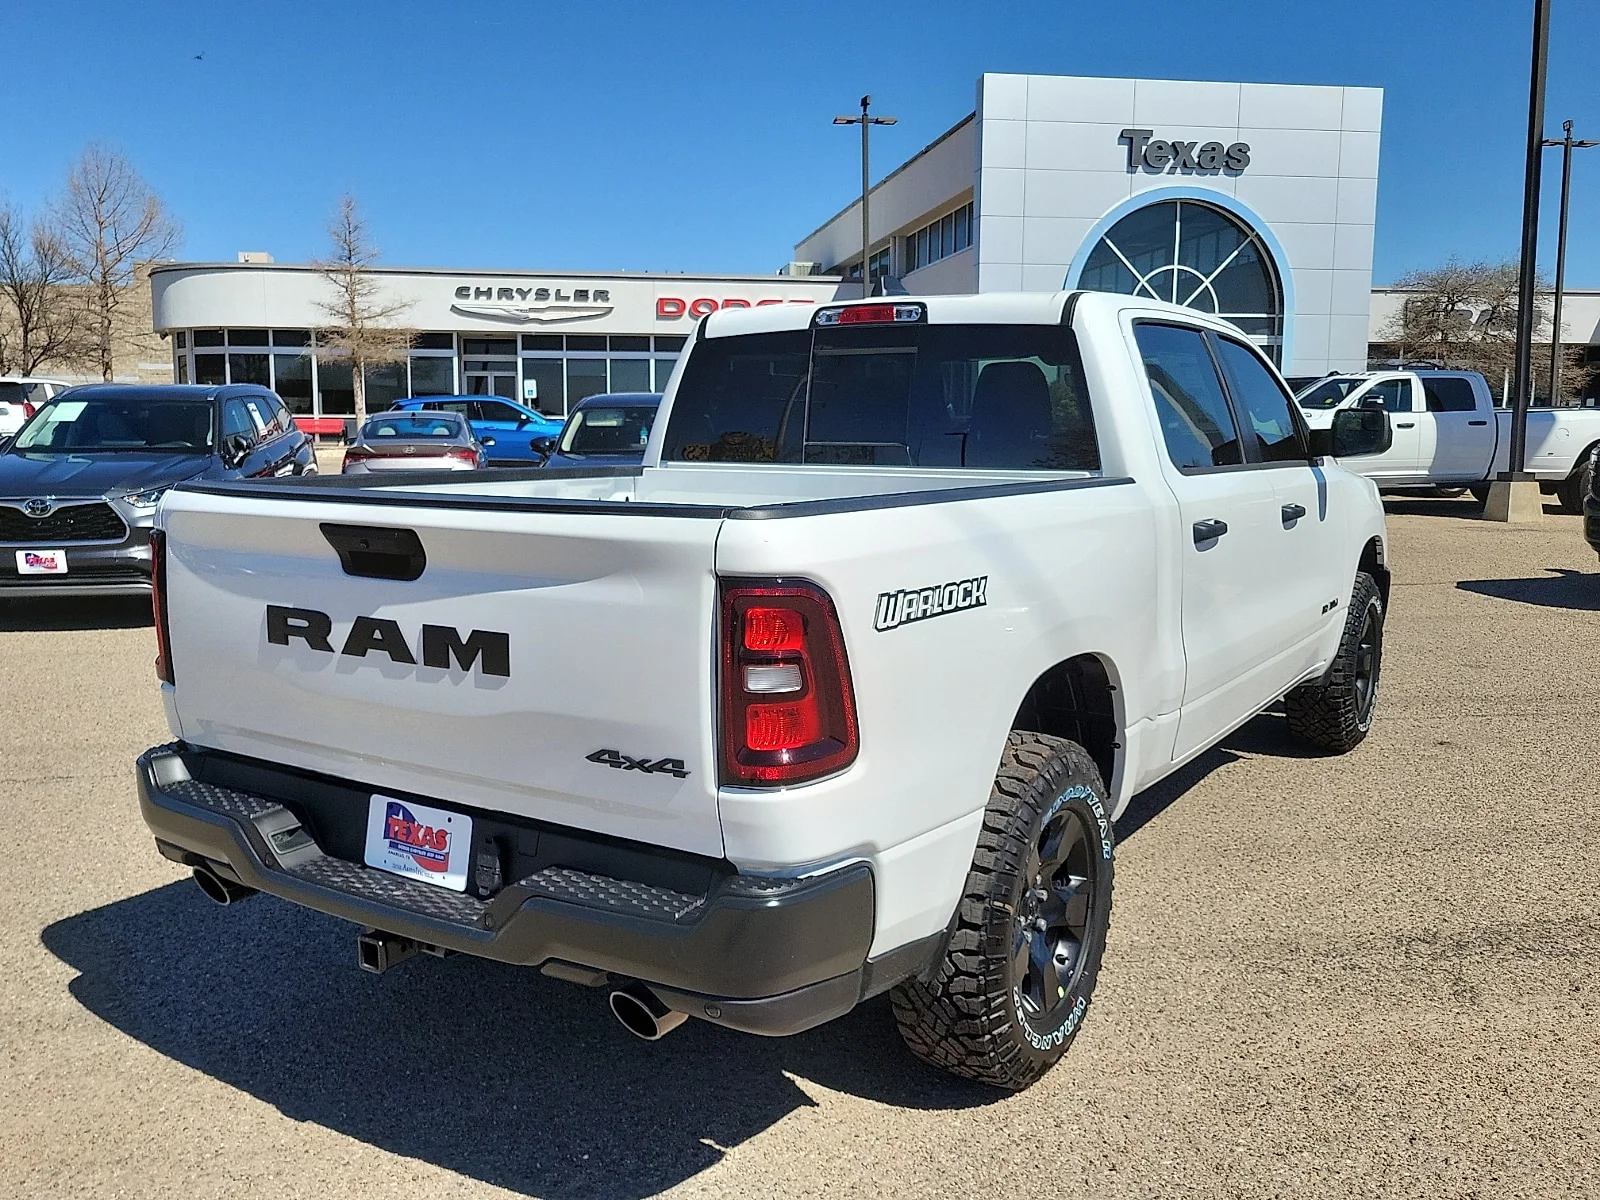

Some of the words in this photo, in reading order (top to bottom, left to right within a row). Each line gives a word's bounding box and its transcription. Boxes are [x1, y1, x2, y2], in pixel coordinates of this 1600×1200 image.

[1119, 128, 1251, 173] Texas
[455, 286, 612, 303] CHRYSLER
[872, 575, 988, 632] WARLOCK
[266, 604, 511, 678] RAM
[388, 816, 448, 851] TEXAS
[1040, 783, 1111, 859] GOODYEAR
[1012, 985, 1087, 1051] WRANGLER
